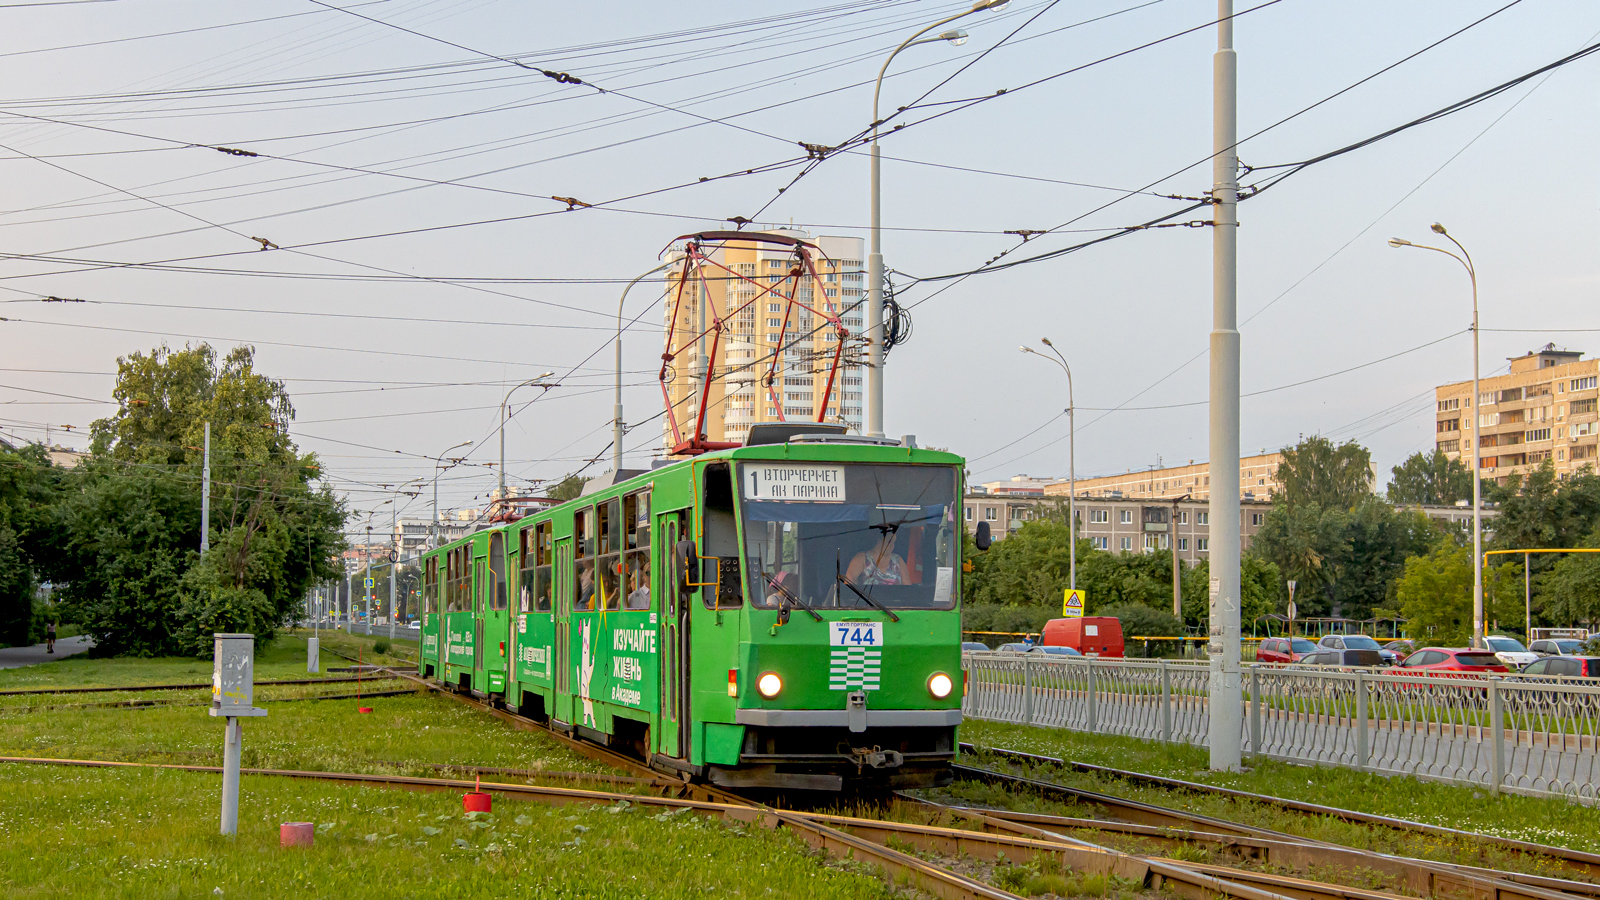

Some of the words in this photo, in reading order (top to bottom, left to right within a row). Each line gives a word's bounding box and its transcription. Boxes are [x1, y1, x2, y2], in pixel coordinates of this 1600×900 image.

[751, 471, 758, 496] 1
[764, 469, 838, 482] ВТОРЧЕРМЕТ
[613, 623, 656, 653] ИЗУЧАЙТЕ
[838, 628, 875, 645] 744
[613, 655, 642, 682] ЖИНЬ
[615, 683, 641, 706] Академе
